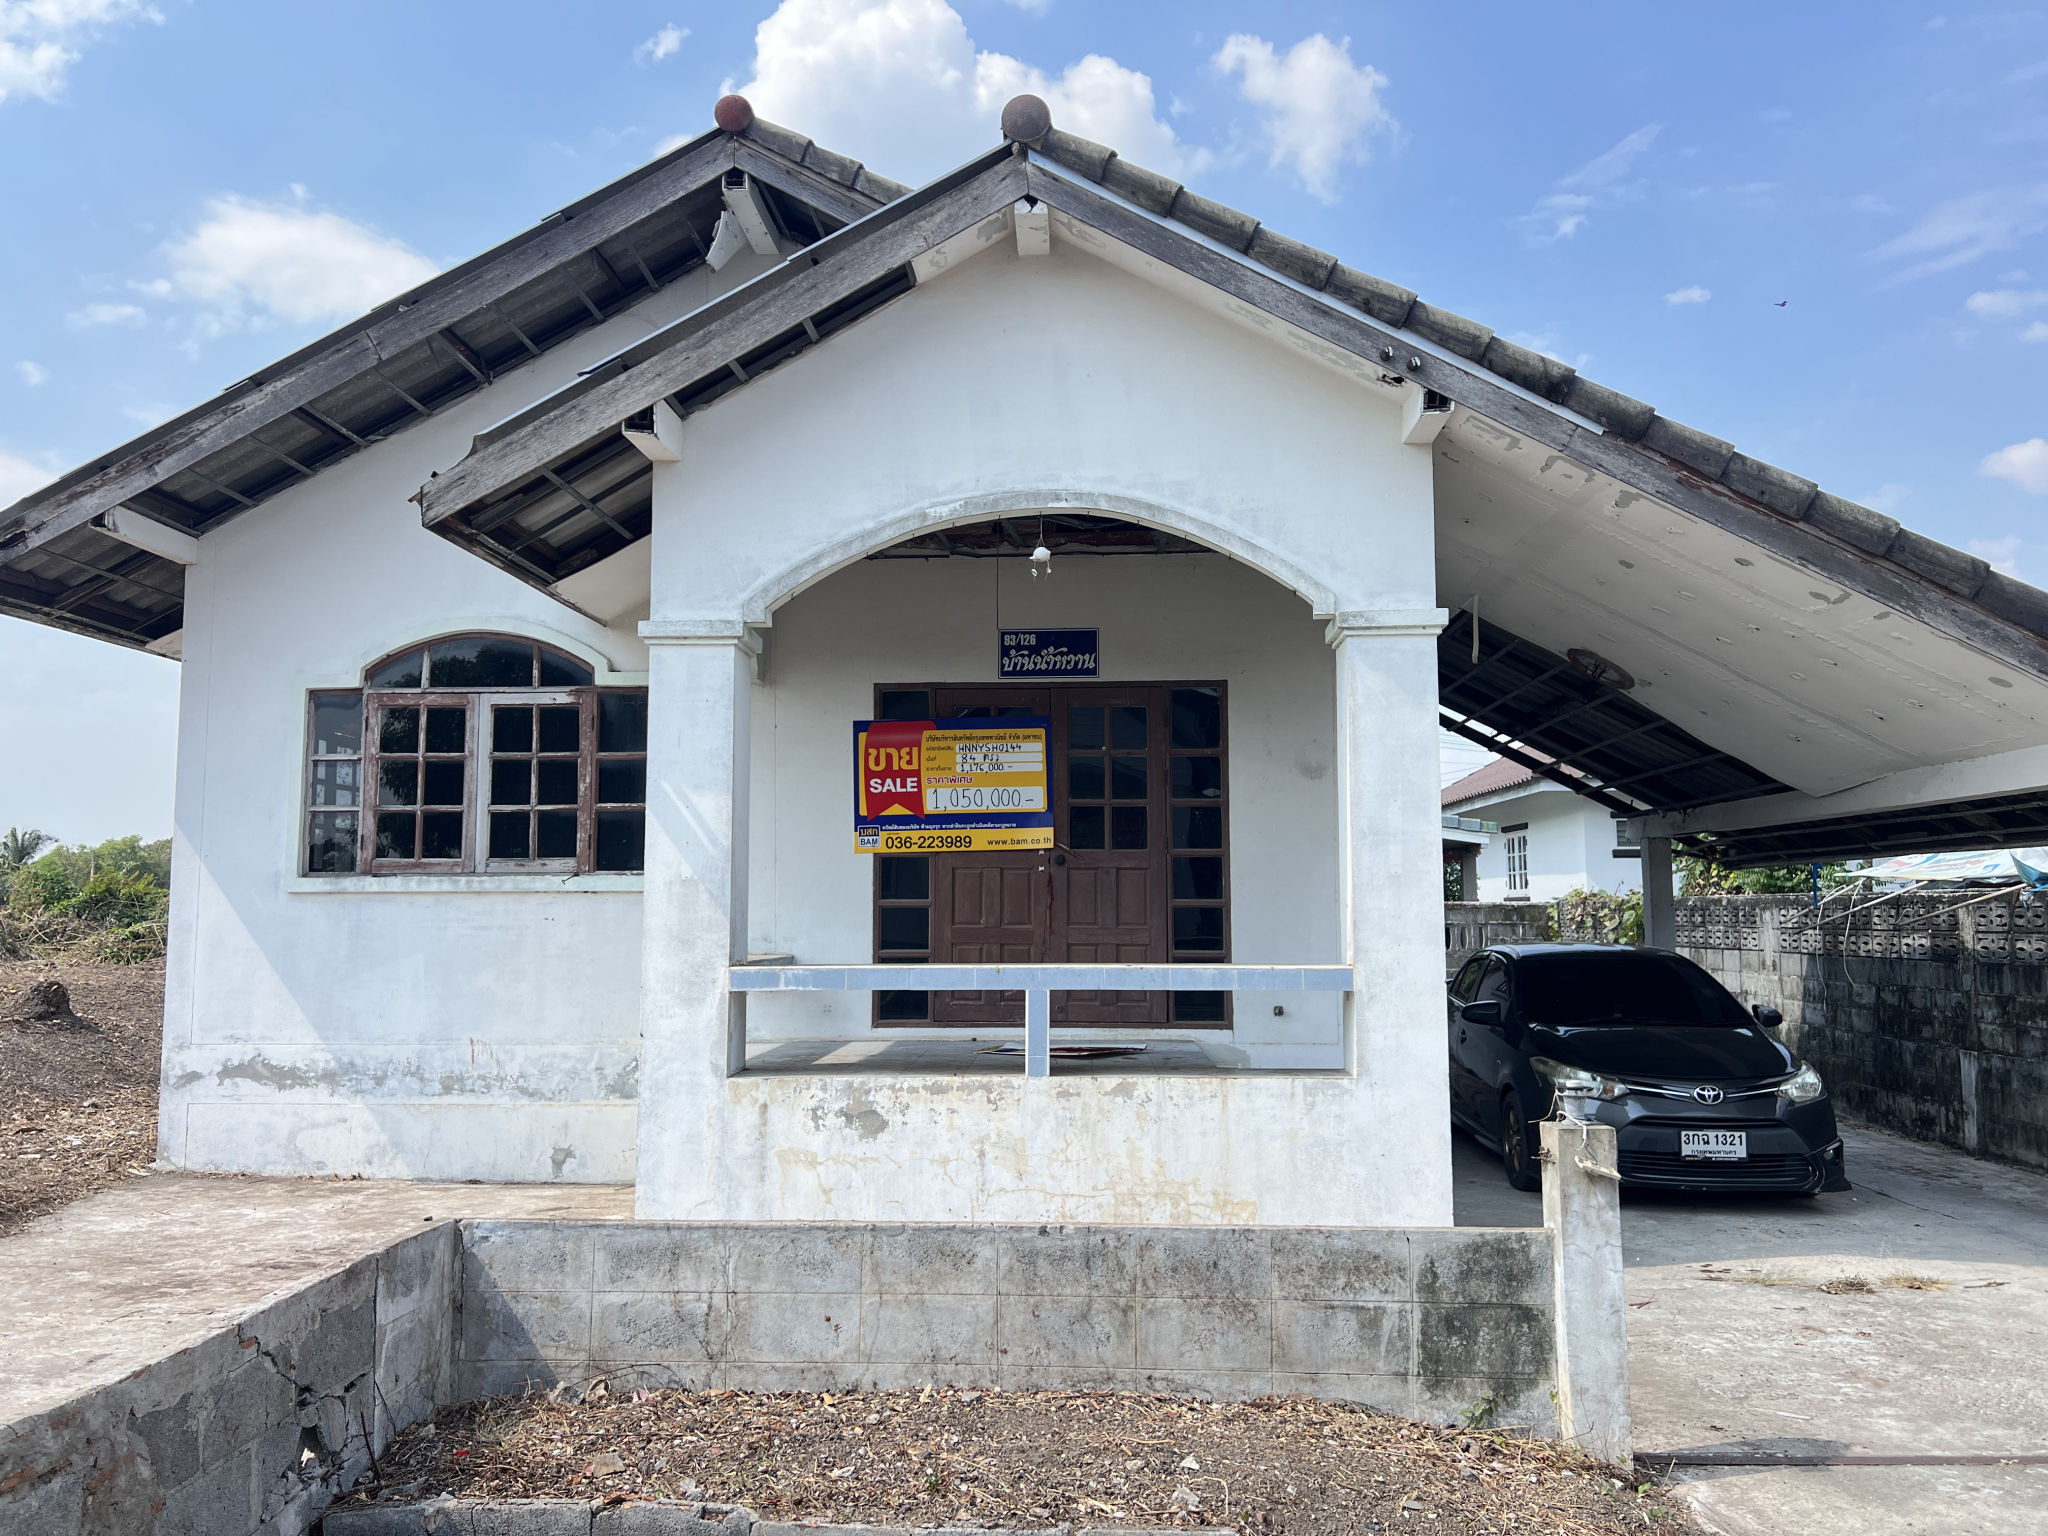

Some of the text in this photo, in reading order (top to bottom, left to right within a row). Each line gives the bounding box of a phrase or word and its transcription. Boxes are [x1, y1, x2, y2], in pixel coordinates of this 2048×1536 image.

[1004, 633, 1036, 646] 93/126
[1002, 646, 1096, 672] บ้านน้ำหวาน
[868, 746, 919, 772] ขาย
[961, 753, 976, 763] 84
[869, 777, 918, 793] SALE
[926, 776, 973, 785] ราคาพิเศษ
[860, 838, 878, 846] BAM
[885, 835, 1052, 849] 036-223989 www.bam.co.th
[1683, 1133, 1743, 1146] 3กฉ 1321
